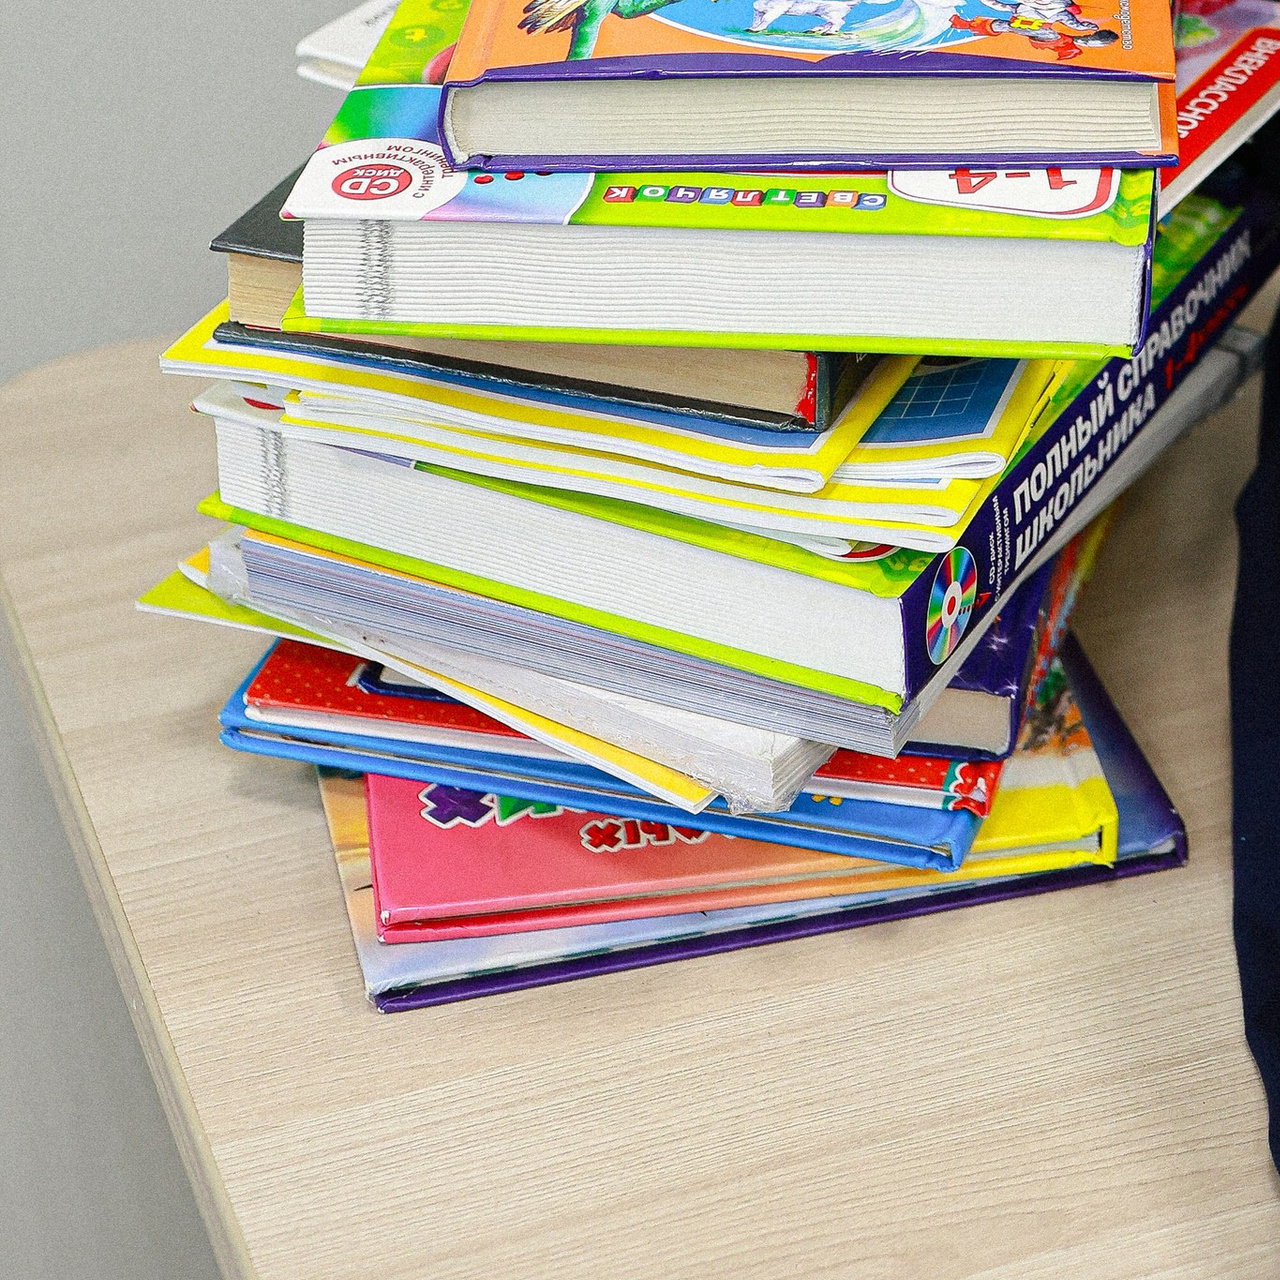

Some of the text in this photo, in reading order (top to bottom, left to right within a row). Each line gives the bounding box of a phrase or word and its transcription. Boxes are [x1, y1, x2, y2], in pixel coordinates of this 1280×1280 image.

[340, 177, 400, 195] CD
[603, 185, 886, 209] СВЕТЛЯЧОК
[1012, 371, 1116, 526] ПОЛНЫЙ
[1117, 229, 1251, 402] СПРАВОЧНИК
[1013, 383, 1157, 572] ШКОЛЬНИКА
